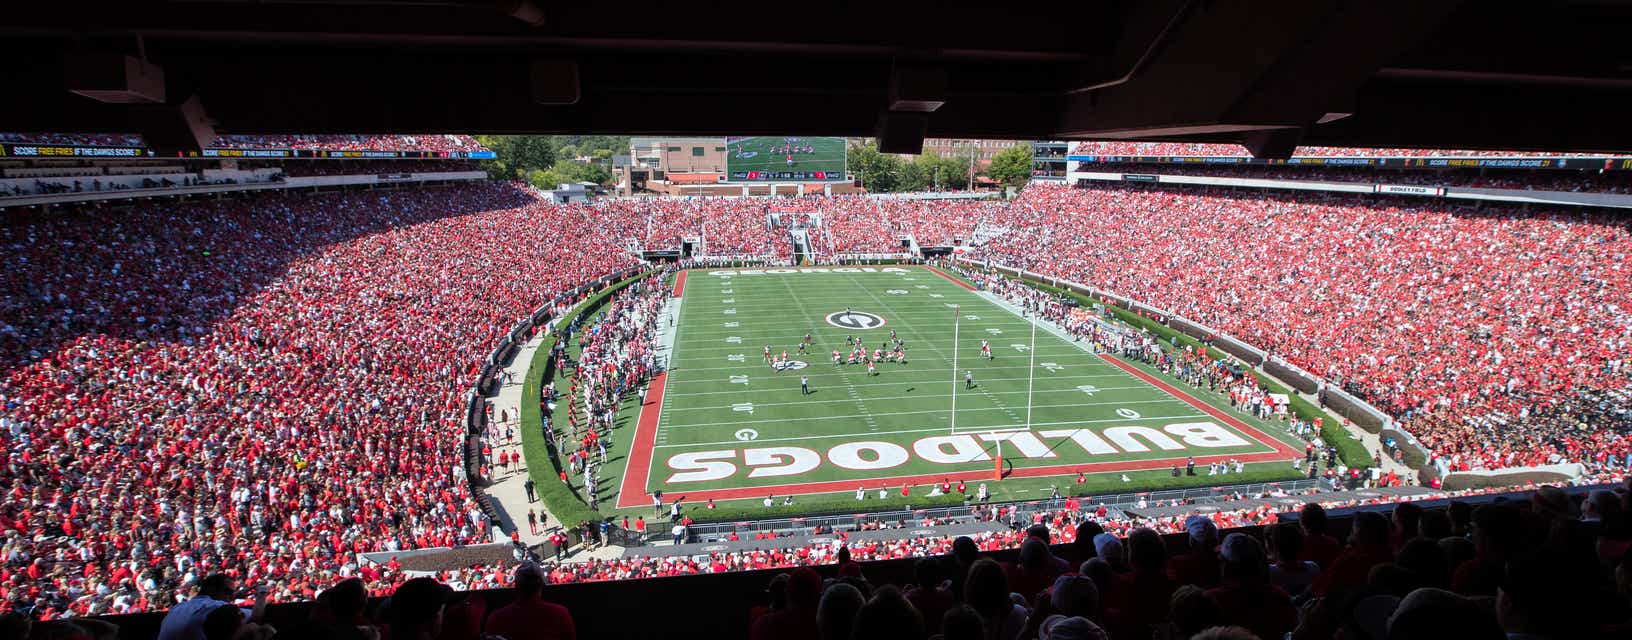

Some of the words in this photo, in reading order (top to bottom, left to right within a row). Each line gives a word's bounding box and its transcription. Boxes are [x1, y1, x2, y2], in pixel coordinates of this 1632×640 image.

[14, 147, 38, 155] SCORE
[38, 147, 55, 155] FREE
[55, 147, 73, 155] FRIES
[74, 147, 81, 155] IF
[94, 148, 115, 156] DAWGS
[115, 148, 135, 156] SCORE
[1486, 159, 1498, 167] THE
[666, 422, 1254, 484] BULLDOGS
